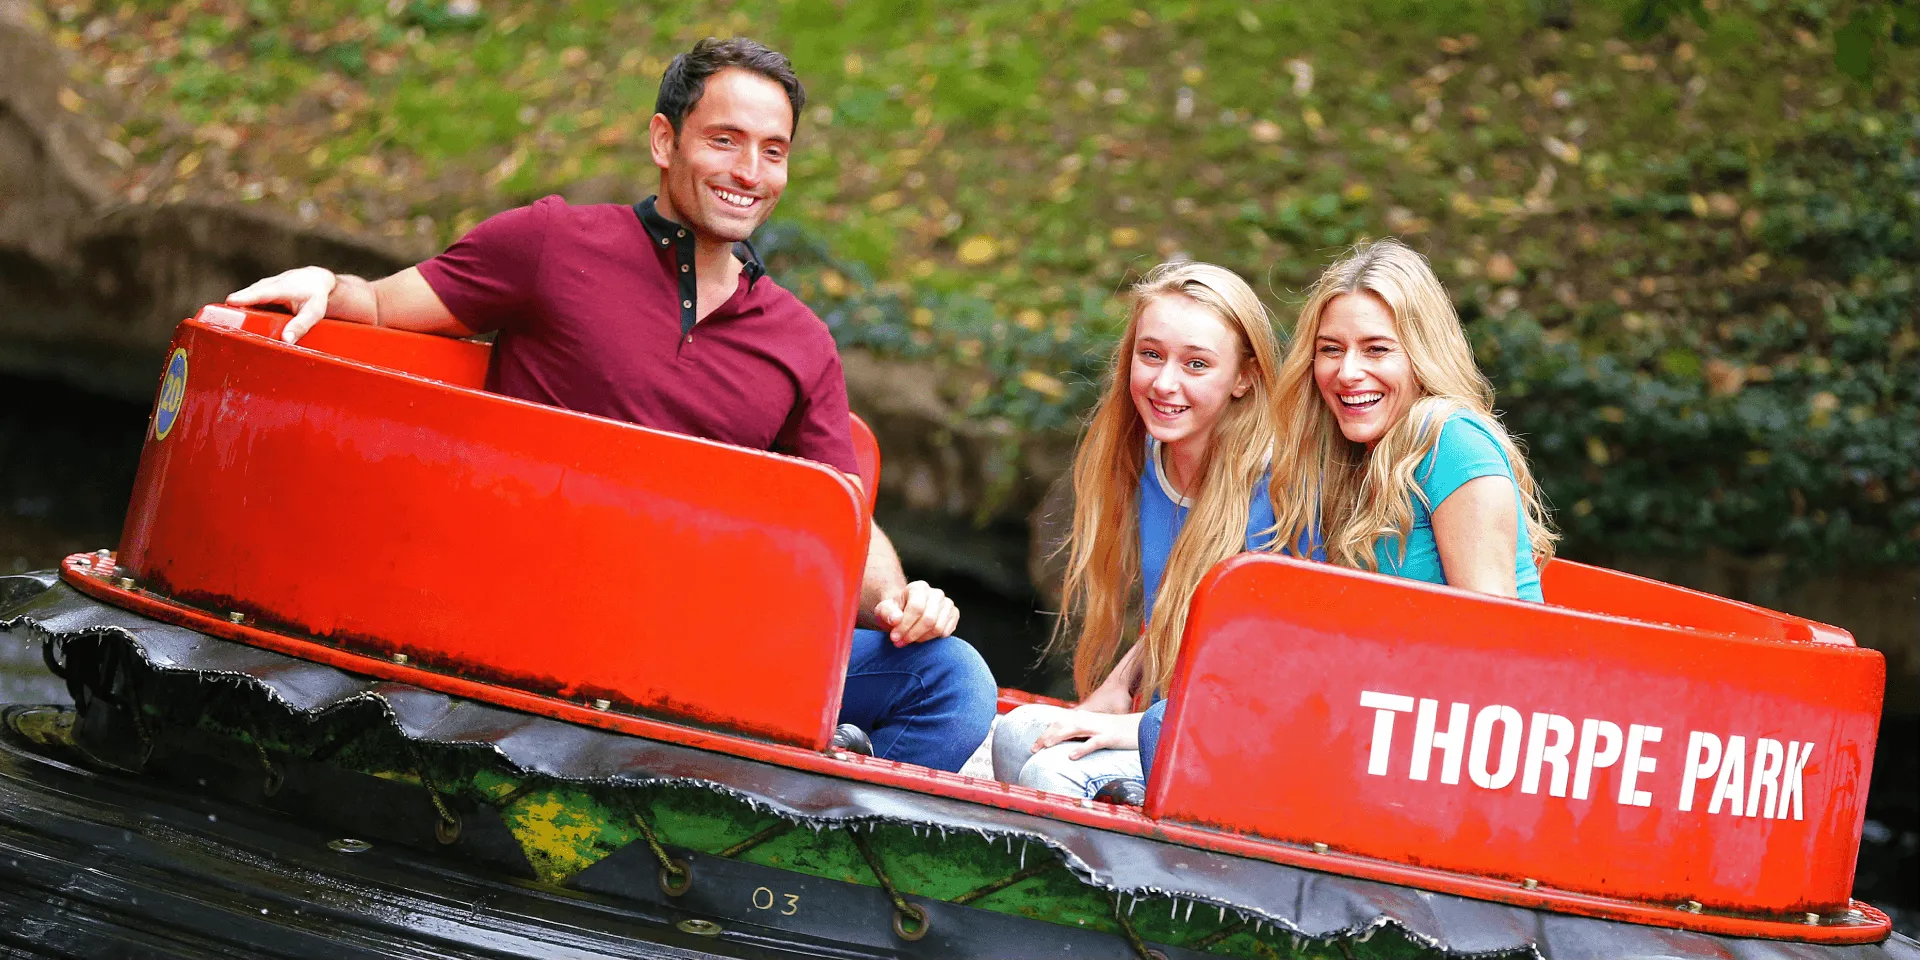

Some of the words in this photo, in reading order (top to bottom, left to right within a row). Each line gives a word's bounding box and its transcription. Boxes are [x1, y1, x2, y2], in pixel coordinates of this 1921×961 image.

[161, 373, 182, 413] 20
[1360, 690, 1663, 807] THORPE
[1678, 730, 1815, 821] PARK
